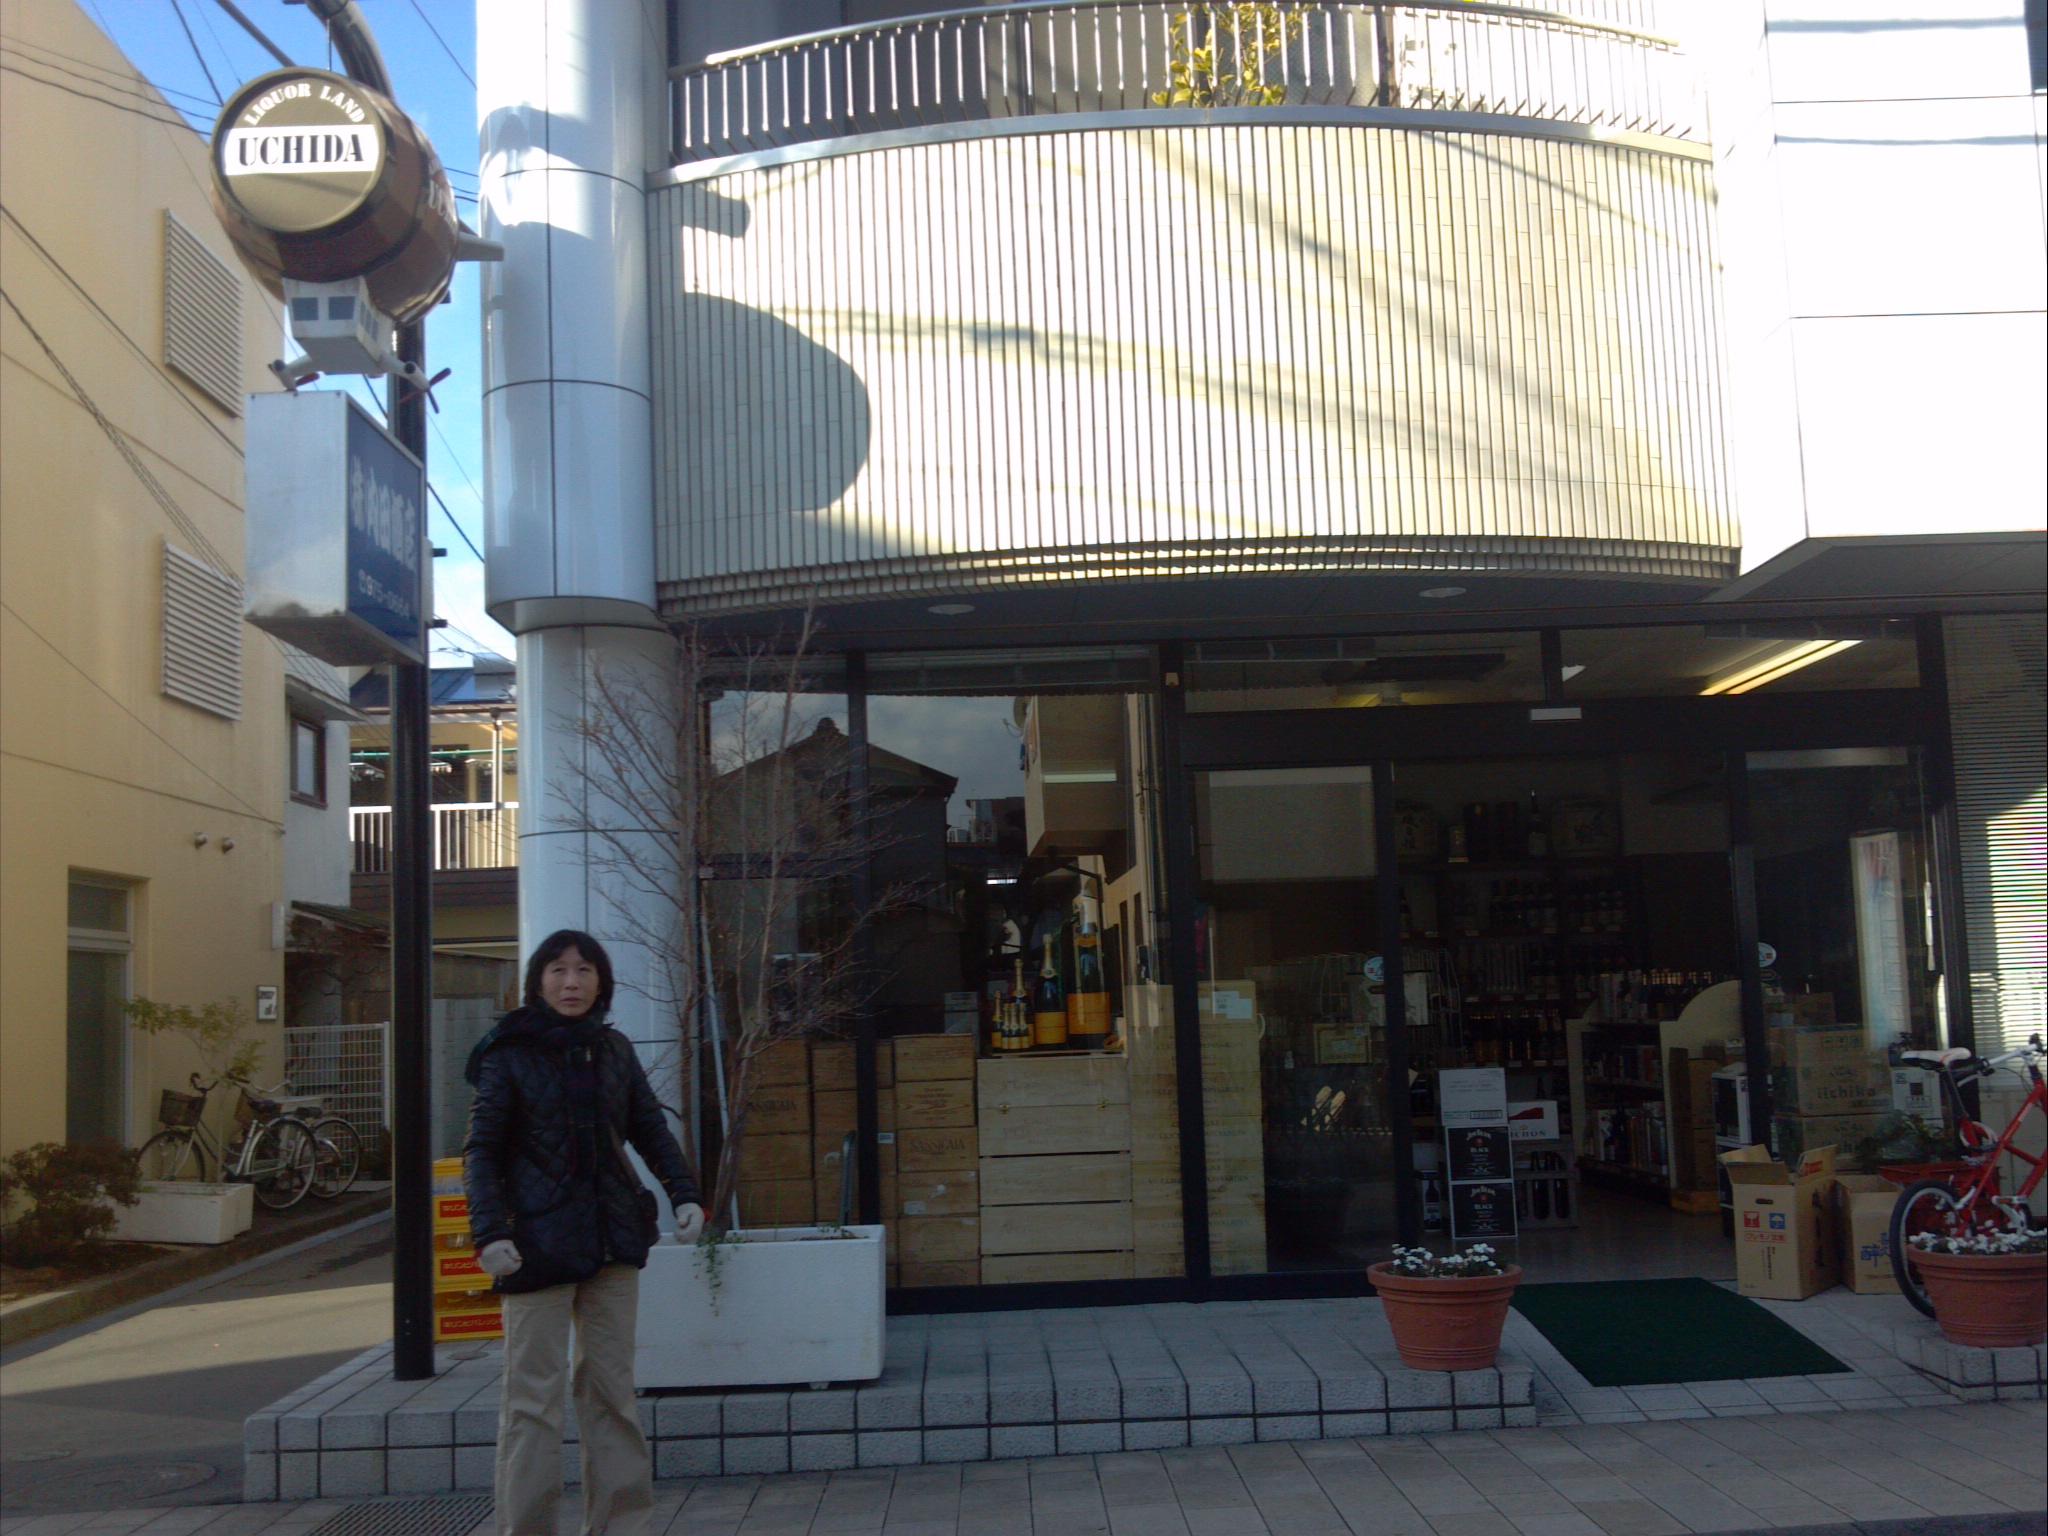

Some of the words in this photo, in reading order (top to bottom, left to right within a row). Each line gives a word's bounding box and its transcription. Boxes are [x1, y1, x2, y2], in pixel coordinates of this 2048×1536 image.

[243, 83, 311, 126] LIQUOR
[319, 86, 366, 124] LAND
[238, 134, 364, 167] UCHIDA
